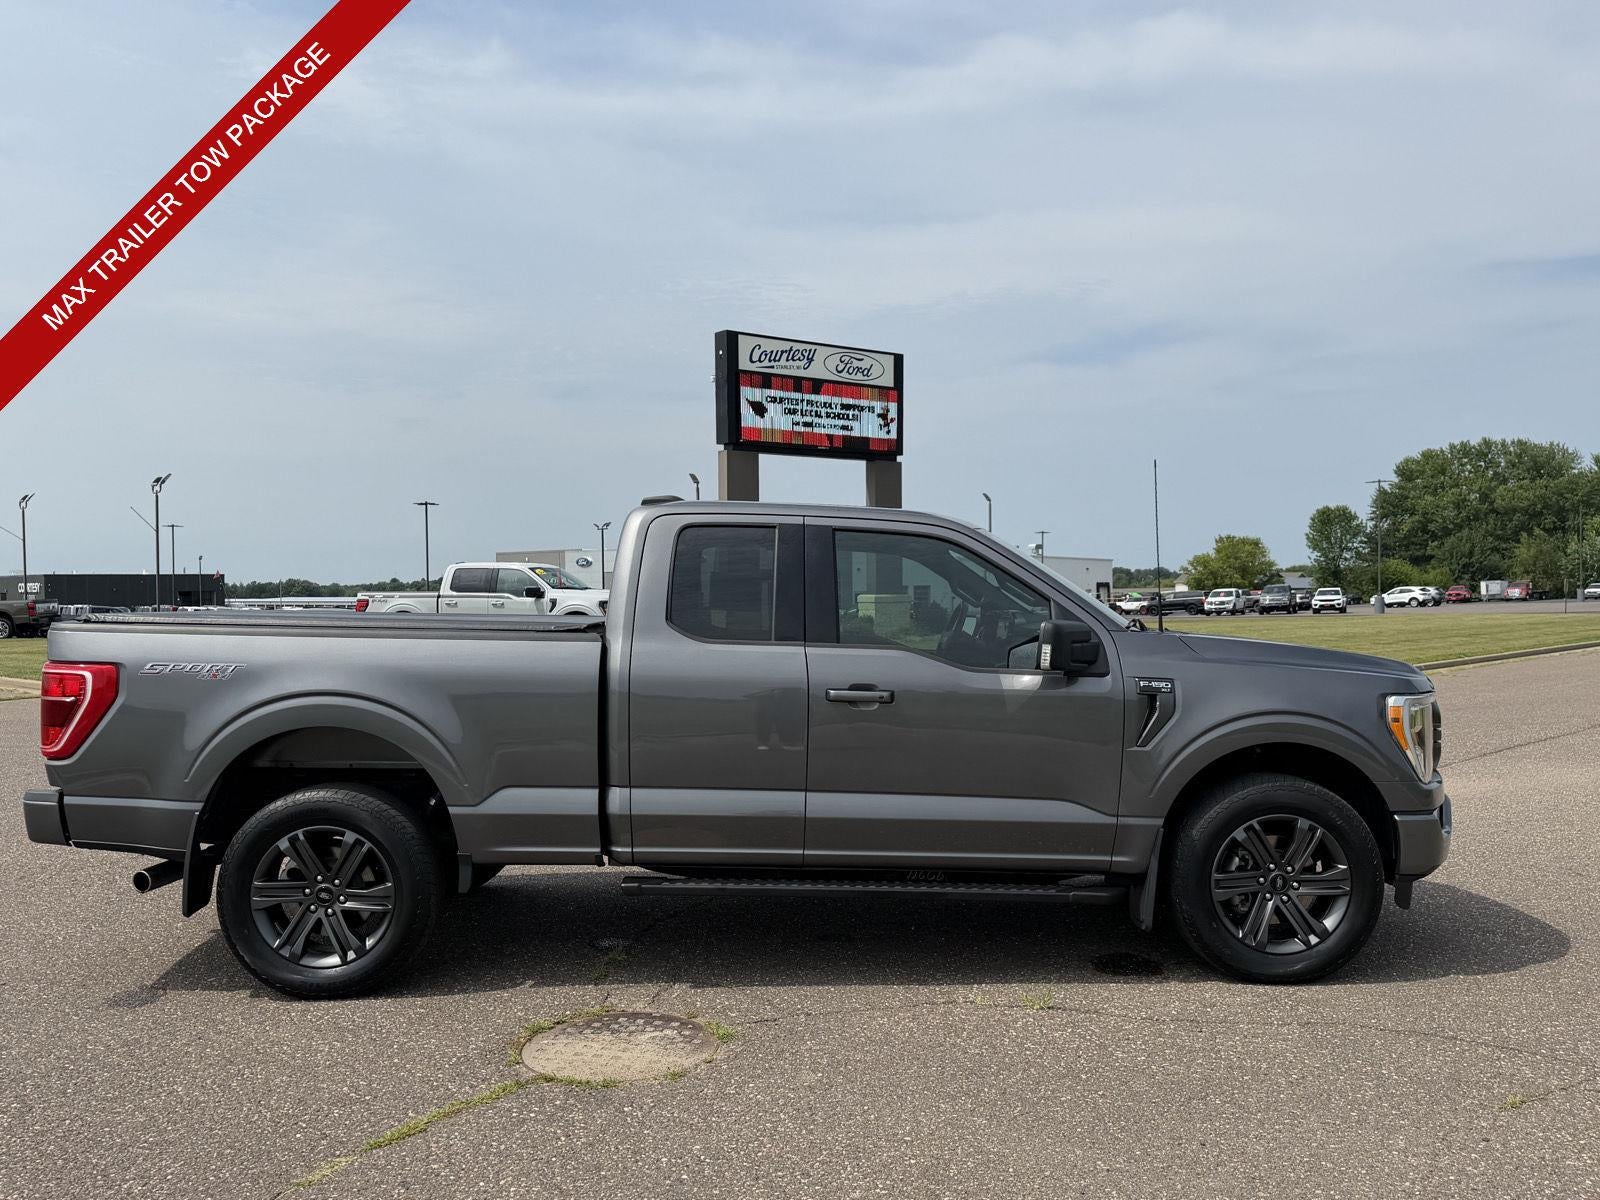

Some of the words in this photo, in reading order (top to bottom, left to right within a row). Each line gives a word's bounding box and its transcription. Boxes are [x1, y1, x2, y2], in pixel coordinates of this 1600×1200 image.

[749, 343, 817, 370] Courtesy
[835, 354, 873, 378] Ford
[765, 395, 805, 406] COURTESY
[806, 399, 838, 410] PROUDLY
[783, 407, 799, 416] OUR
[800, 409, 823, 419] LOCAL
[17, 583, 40, 593] CORTESY
[138, 662, 248, 676] SPORT
